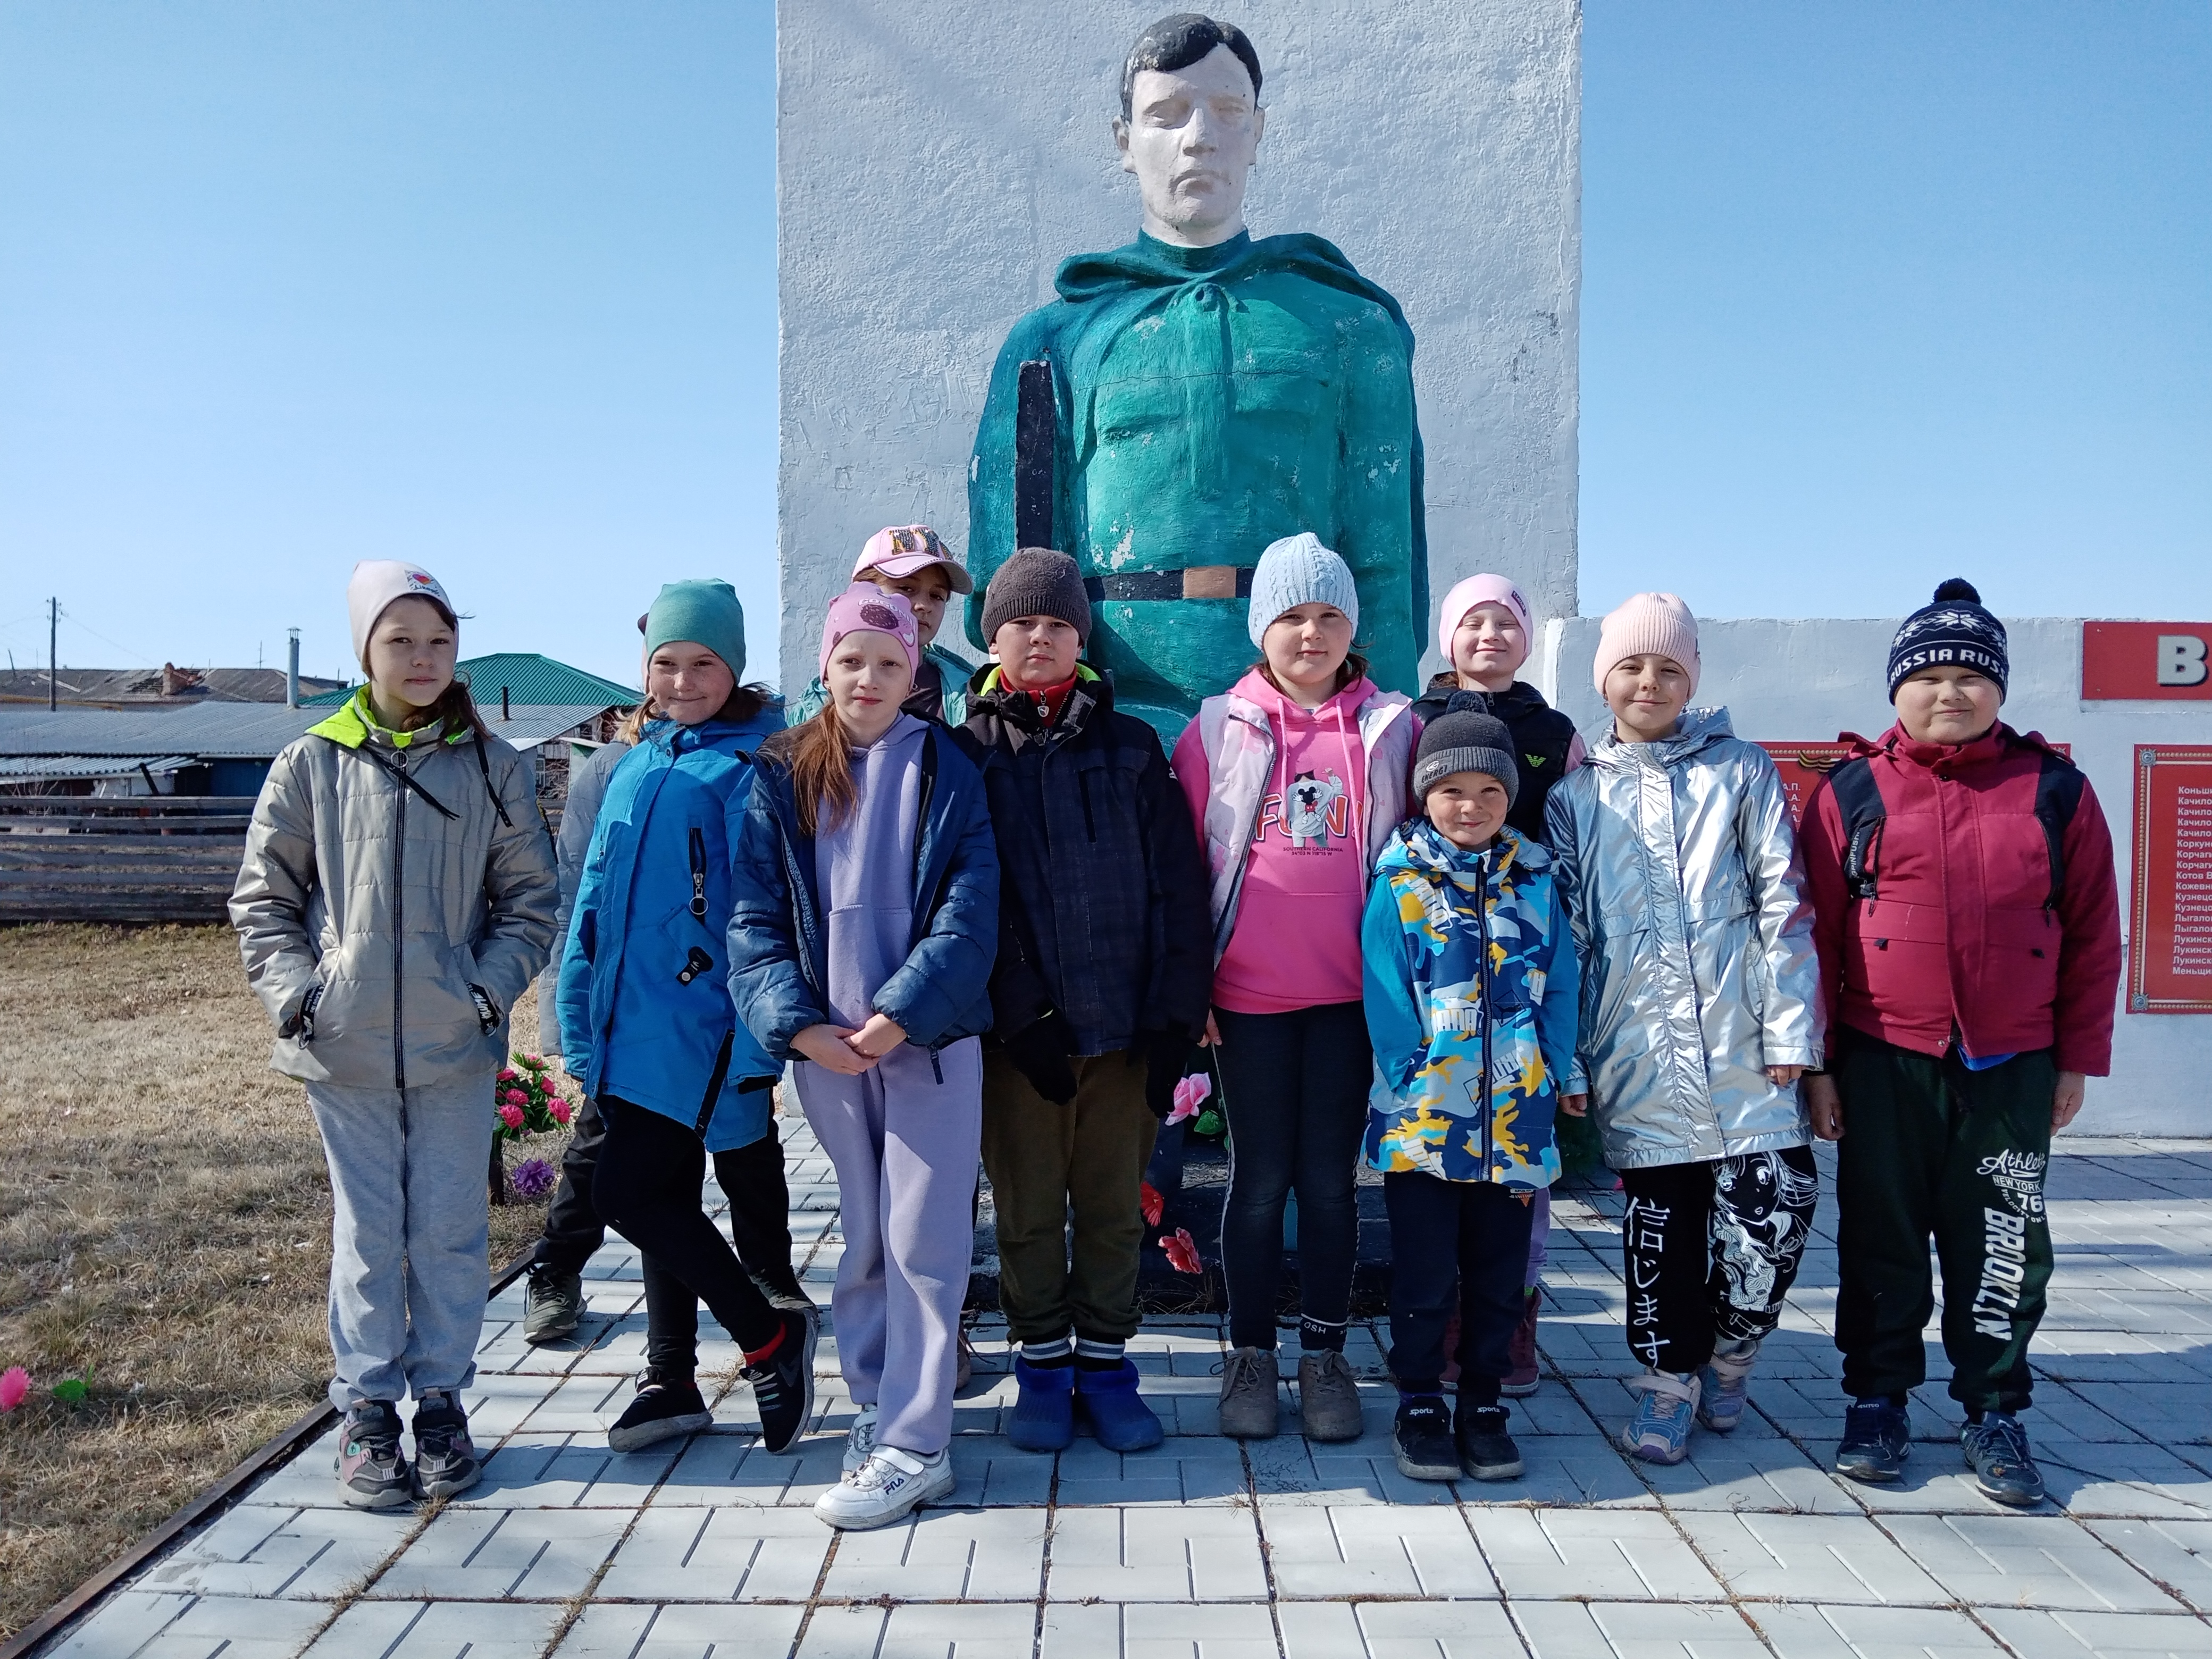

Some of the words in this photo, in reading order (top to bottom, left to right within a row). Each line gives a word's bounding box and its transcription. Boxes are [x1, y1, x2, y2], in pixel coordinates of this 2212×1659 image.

[1890, 648, 1953, 686] RUSSIA
[1960, 649, 2006, 683] RUSS
[2172, 956, 2212, 966] Лукинск
[2172, 967, 2212, 976] Меньщи
[1993, 1176, 2014, 1187] NEW
[2014, 1180, 2041, 1192] YORK
[2017, 1192, 2043, 1212] 76
[2031, 1212, 2046, 1223] ONL
[1409, 1407, 1434, 1417] sports
